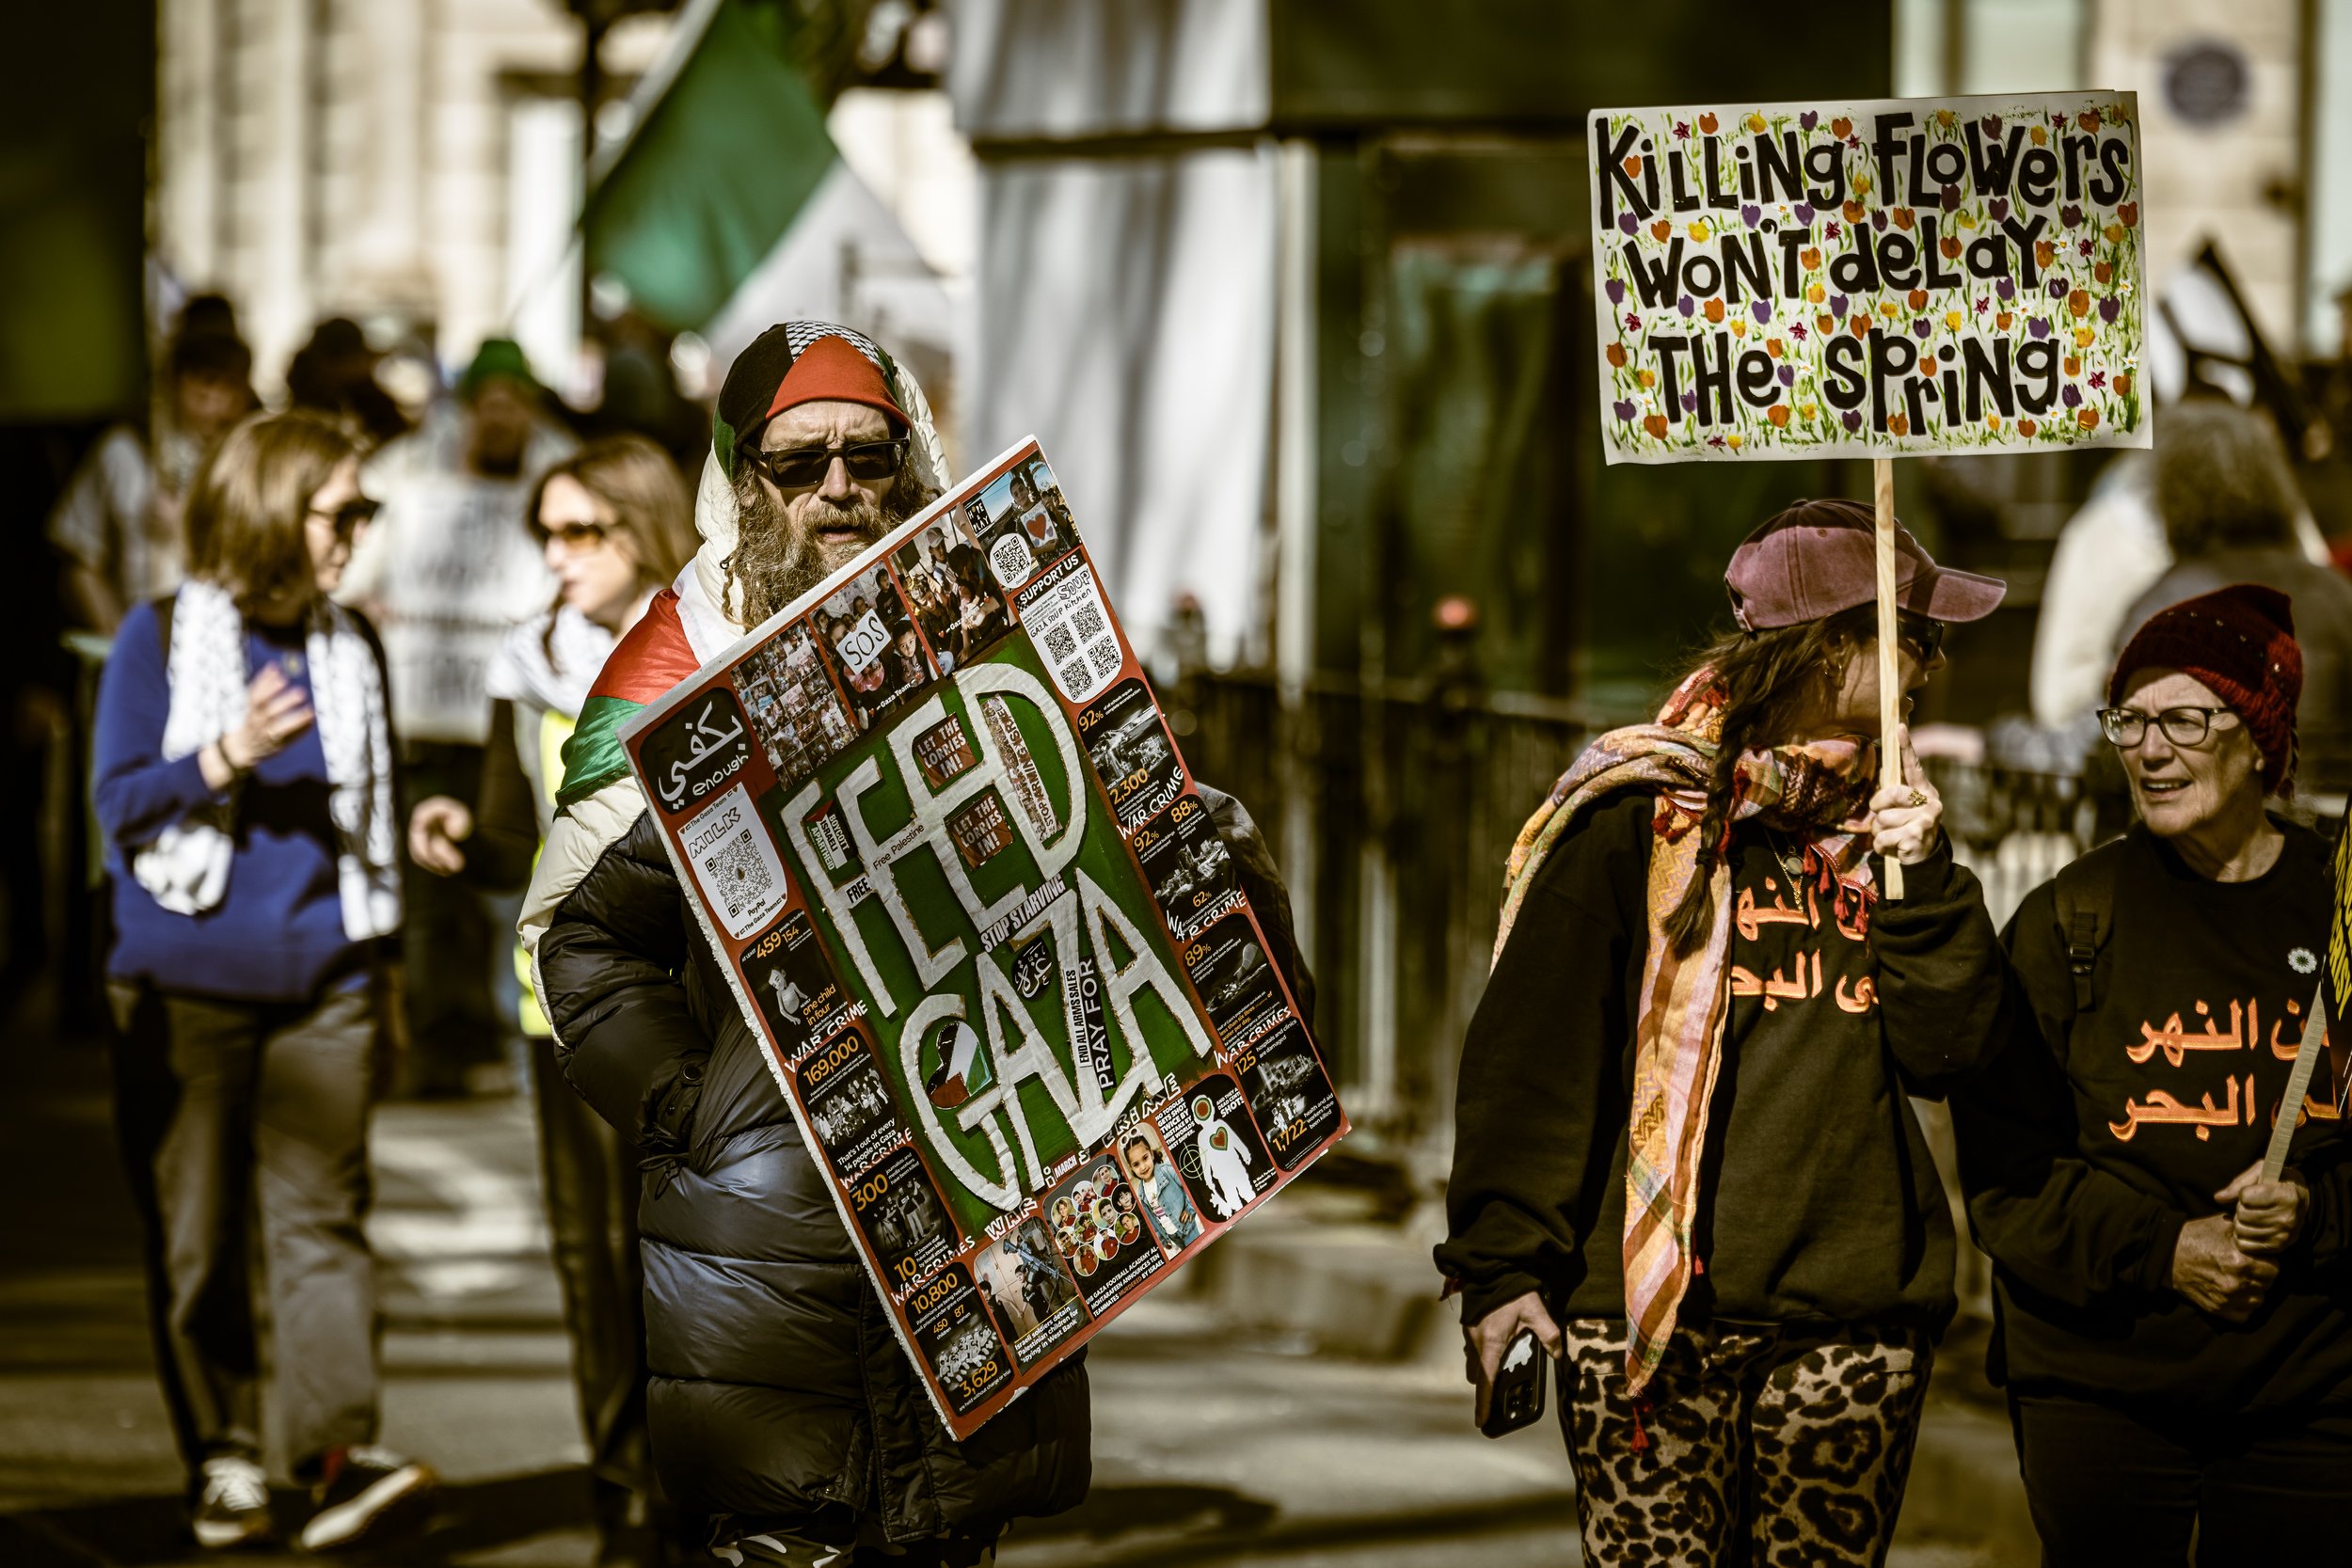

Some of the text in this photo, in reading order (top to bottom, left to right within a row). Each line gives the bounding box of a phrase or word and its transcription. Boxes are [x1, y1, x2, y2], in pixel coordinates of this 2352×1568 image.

[1019, 553, 1079, 606] SUPPORT US
[1057, 569, 1089, 599] SOUP
[843, 615, 884, 666] SOS
[1029, 620, 1048, 638] GAZA
[1047, 608, 1064, 625] SOUP
[880, 681, 911, 708] Gaza Team
[1077, 704, 1104, 733] 92%
[917, 718, 961, 756] LET THE
[923, 731, 967, 769] LORRIES
[692, 753, 748, 794] enough
[940, 752, 963, 779] IN!
[1108, 766, 1151, 806] 2,300
[1116, 808, 1149, 839] WAR
[1149, 765, 1183, 814] CRIME
[690, 795, 727, 827] The Gaza Team
[954, 796, 997, 835] LET THE
[1037, 800, 1055, 827] STOP
[1169, 794, 1199, 824] 88%
[688, 806, 740, 859] MILK
[777, 663, 1086, 1020] FEED
[818, 818, 839, 852] ISRAELI
[828, 813, 850, 851] BOYCOTT
[872, 823, 925, 871] Free Palestine
[961, 810, 1004, 849] LORRIES
[977, 831, 1000, 857] IN!
[1133, 824, 1160, 853] 92%
[810, 825, 835, 870] APARTHEID
[747, 897, 766, 917] PayPal
[846, 877, 871, 904] FREE
[1191, 886, 1212, 908] 62%
[744, 901, 778, 931] The Gaza Team
[979, 872, 1066, 954] STOP STARVING
[1203, 891, 1247, 927] CRIME
[754, 929, 783, 961] 459
[782, 924, 800, 943] 154
[1183, 937, 1212, 967] 89%
[802, 983, 836, 1017] one child
[805, 1000, 832, 1026] in four
[1066, 969, 1089, 1062] END ALL ARMS SALES
[784, 1034, 823, 1072] WAR
[826, 999, 868, 1037] CRIME
[900, 867, 1213, 1208] GAZA
[1081, 960, 1113, 1084] PRAY FOR
[1214, 1037, 1248, 1069] WAR
[1249, 1006, 1290, 1042] CRIMES
[1255, 1018, 1297, 1053] hospitals and clinics
[2126, 997, 2259, 1068] النهر
[796, 1019, 854, 1074] 169,000
[1265, 1034, 1287, 1053] damaged
[1233, 1050, 1257, 1076] 125
[1154, 1096, 1184, 1121] NO TODDLER
[1157, 1101, 1186, 1127] GETS SHOT
[1160, 1107, 1190, 1134] TWICE BY
[1217, 1099, 1230, 1111] DEAD
[1303, 1091, 1334, 1118] health and aid
[1306, 1099, 1334, 1124] workers have
[1309, 1108, 1332, 1129] been killed
[2108, 1073, 2256, 1142] البحر
[837, 1147, 857, 1166] That's
[859, 1136, 870, 1149] out
[869, 1131, 879, 1141] of
[877, 1117, 896, 1135] every
[1163, 1115, 1192, 1140] MISTAKE BY
[1166, 1134, 1176, 1146] THE
[1168, 1140, 1179, 1150] BEST
[1272, 1117, 1308, 1154] 1,722
[839, 1127, 914, 1188] WAR CRIME
[844, 1126, 896, 1172] 14 people in Gaza
[1053, 1152, 1077, 1179] MARCH
[850, 1171, 890, 1212] 300
[891, 1235, 976, 1306] WAR CRIMES
[894, 1253, 919, 1284] 10
[1090, 1252, 1160, 1310] MOHTARAFEEN ANNOUNCES TEN
[1093, 1285, 1107, 1299] GAZA
[1106, 1268, 1129, 1289] FOOTBALL
[1128, 1251, 1151, 1272] ACADEMY
[912, 1270, 960, 1317] 10,800
[1092, 1258, 1165, 1318] TEAMMATES MURDERED BY ISRAEL
[931, 1304, 966, 1336] 450 87
[1014, 1305, 1071, 1351] Israeli soldiers detain
[1018, 1307, 1079, 1357] Palestinian children for
[1041, 1339, 1049, 1349] in
[1047, 1328, 1063, 1344] West
[1061, 1317, 1077, 1333] Bank
[959, 1358, 1000, 1400] 3,629
